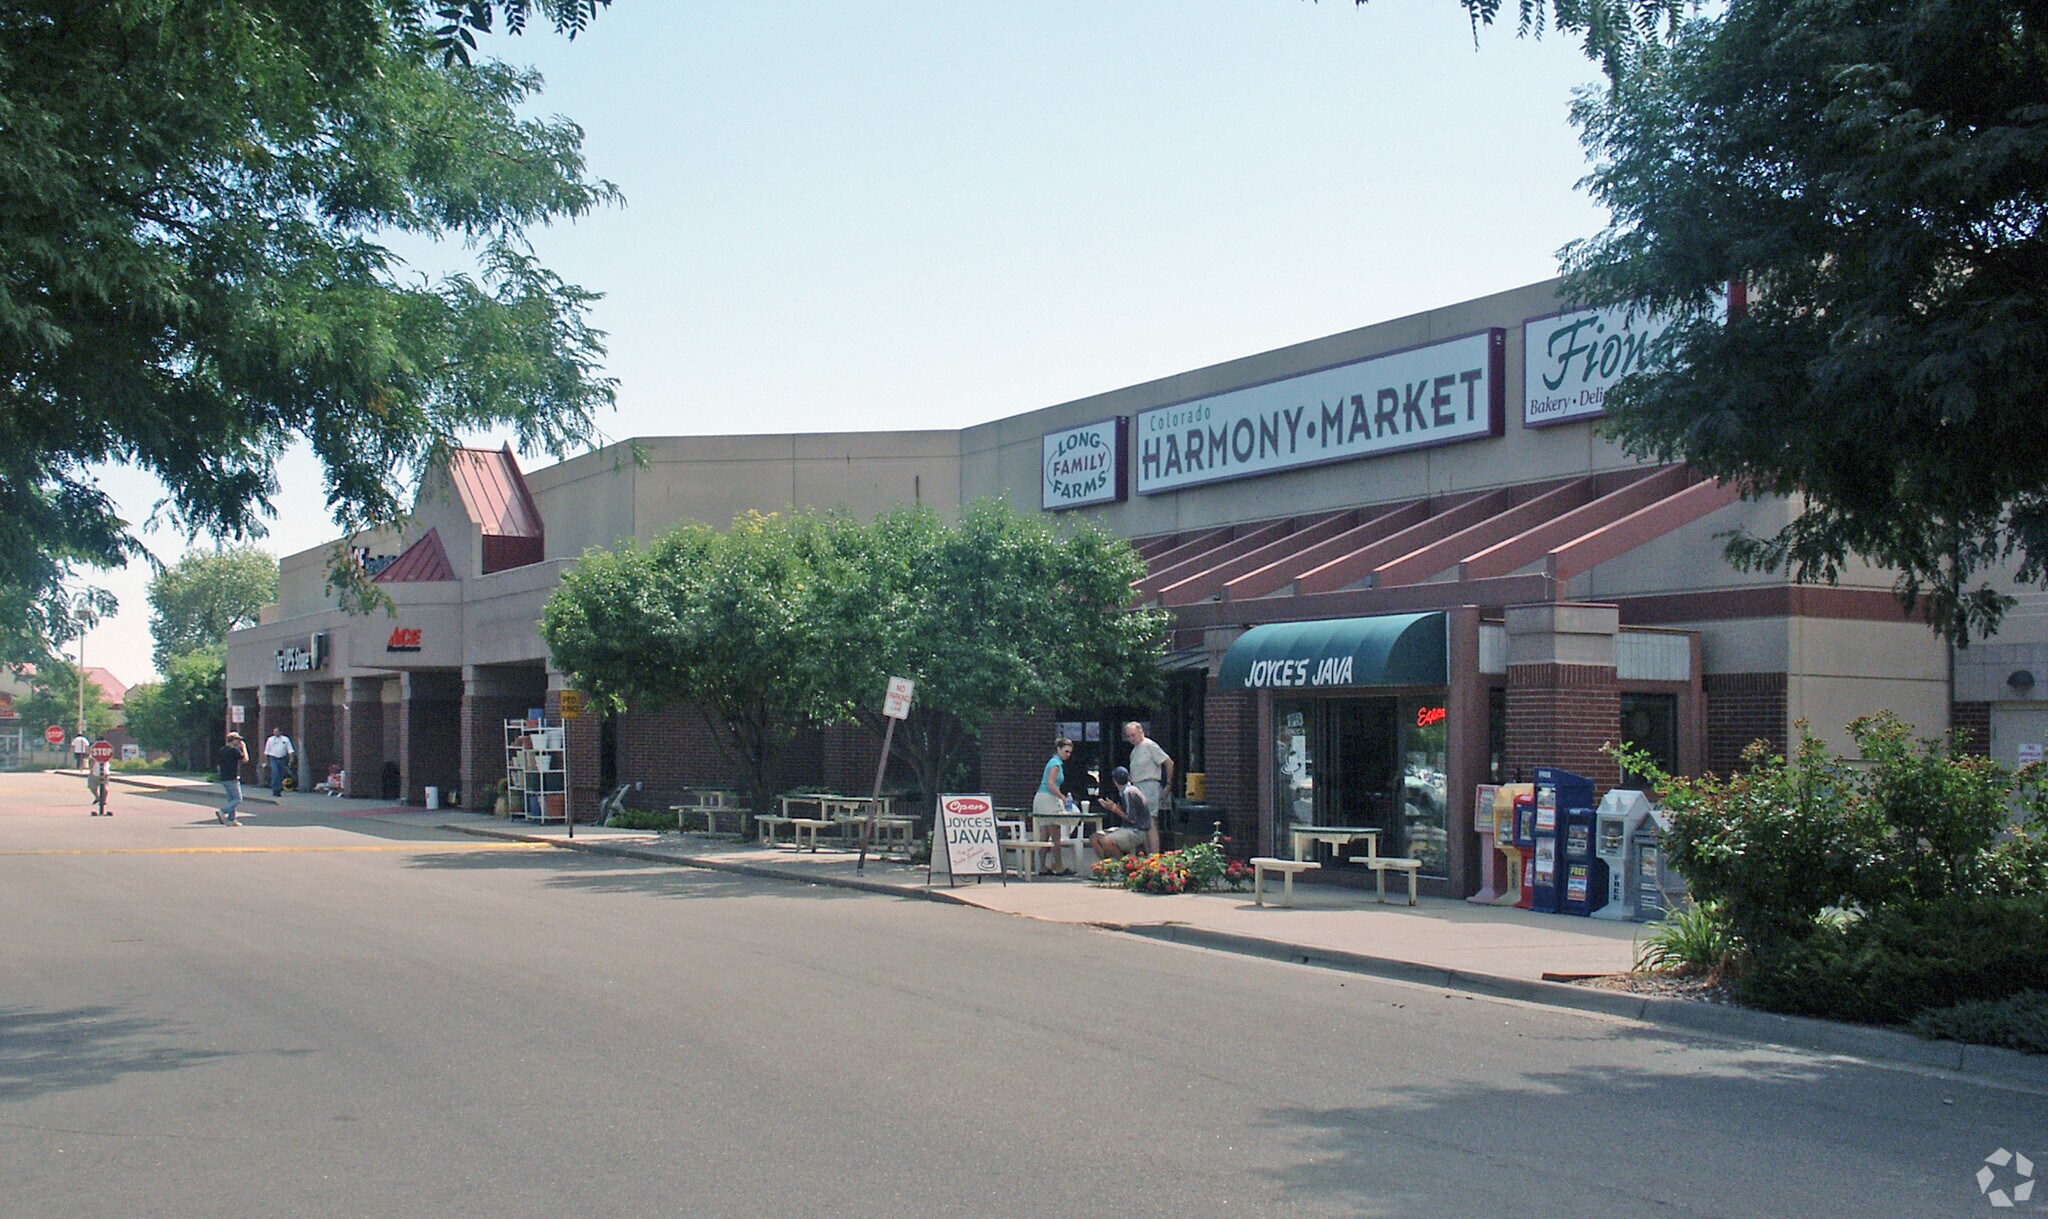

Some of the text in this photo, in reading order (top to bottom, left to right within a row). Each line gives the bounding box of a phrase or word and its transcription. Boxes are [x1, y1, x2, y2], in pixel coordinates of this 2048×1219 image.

[1530, 396, 1570, 415] Bakery
[1142, 368, 1482, 480] HARMONY MARKET
[1150, 404, 1211, 431] Colorado
[1058, 432, 1100, 457] LONG
[1053, 451, 1106, 477] FAMILY
[1053, 470, 1107, 498] FARMS
[388, 626, 421, 646] ACE
[1244, 655, 1353, 687] JOYCE'S JAVA
[896, 684, 905, 692] NO
[47, 730, 63, 738] STOP
[92, 748, 112, 756] STOP
[949, 800, 986, 813] Open
[947, 817, 993, 828] JOYCE'S
[949, 829, 994, 844] JAVA
